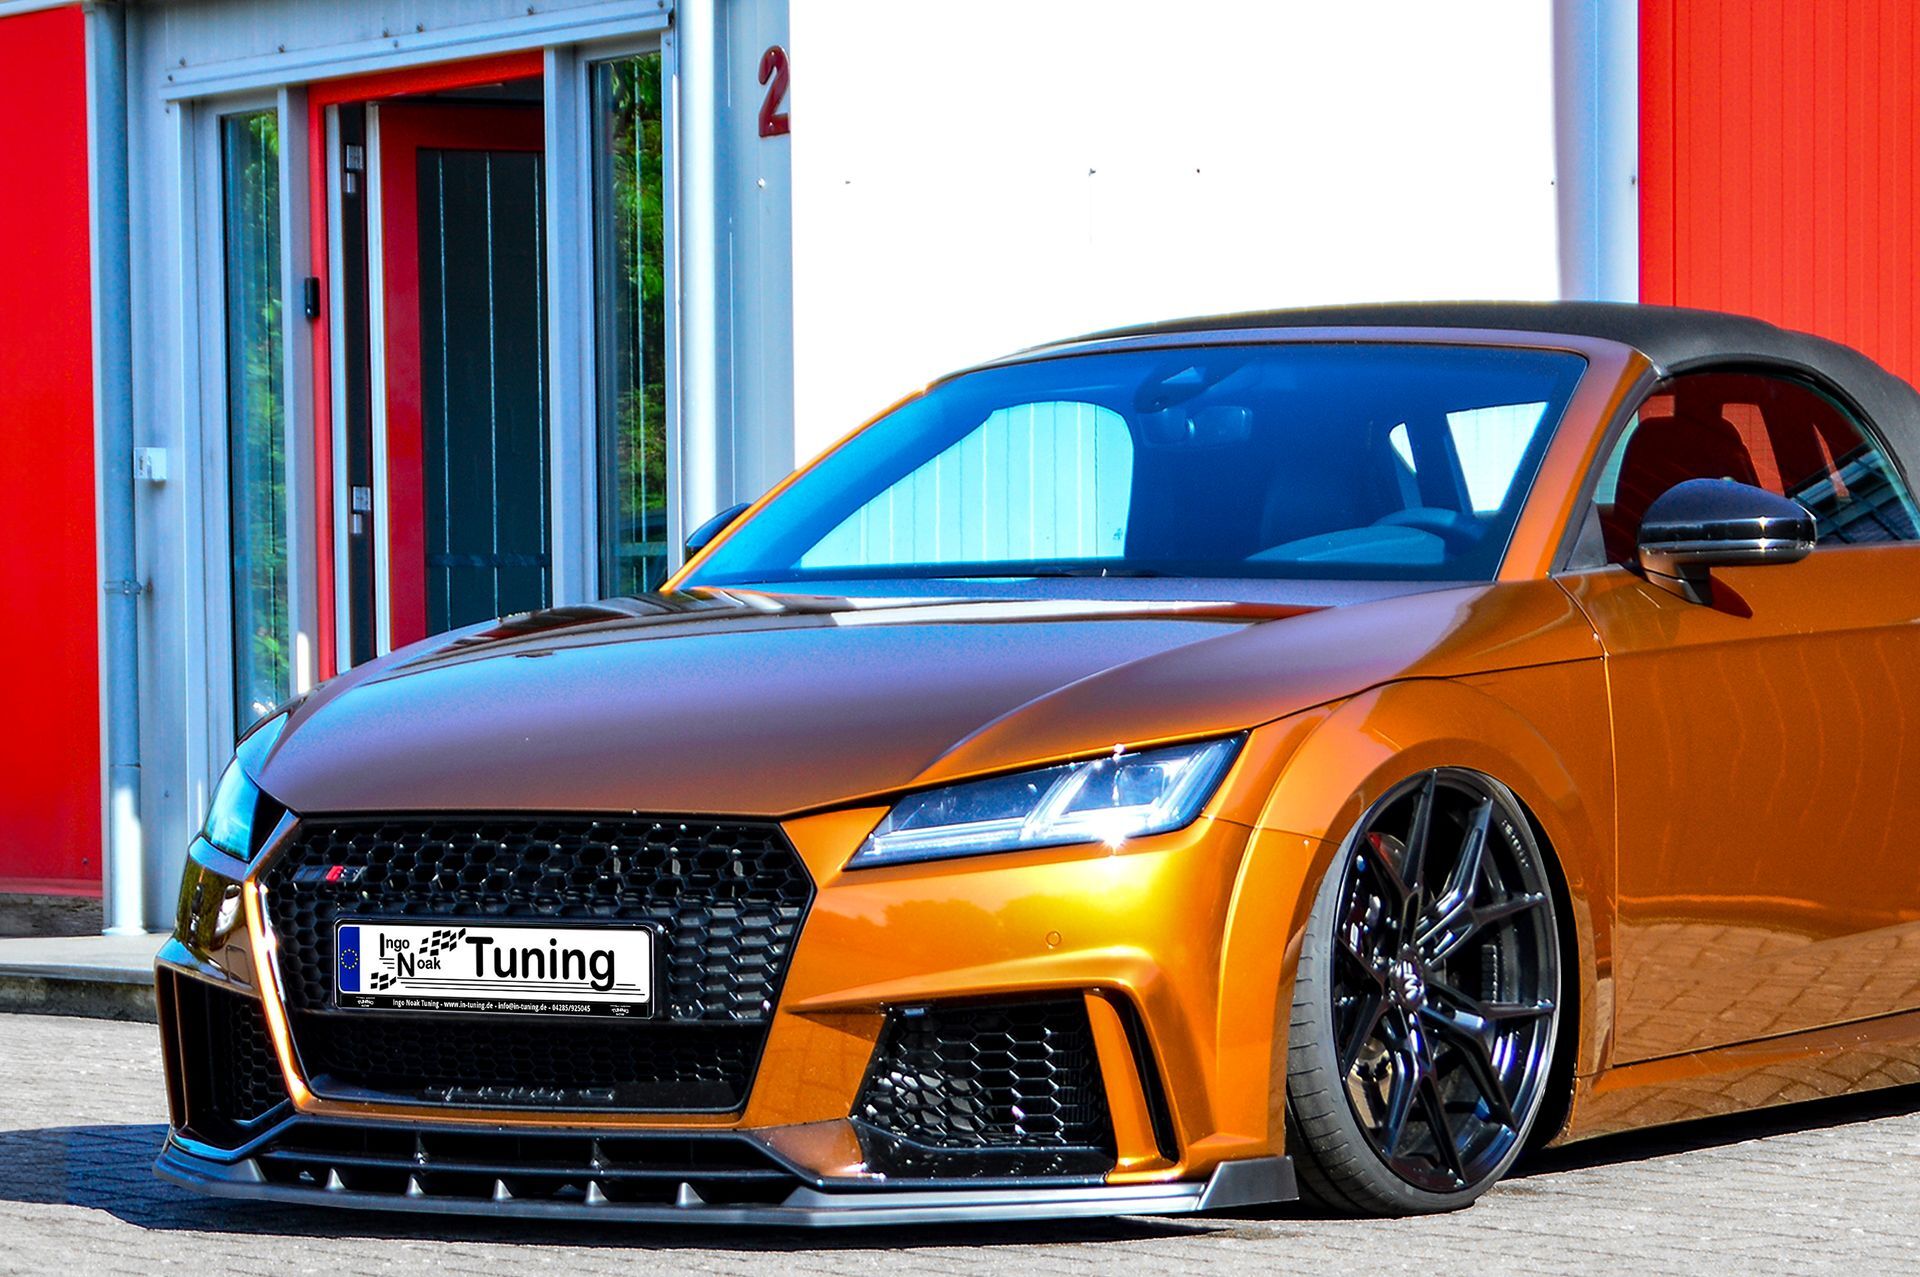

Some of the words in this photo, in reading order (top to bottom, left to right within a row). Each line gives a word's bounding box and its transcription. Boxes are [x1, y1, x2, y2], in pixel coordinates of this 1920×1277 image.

[758, 44, 790, 138] 2
[380, 933, 410, 957] Ingo
[397, 952, 441, 977] Noak
[465, 936, 615, 992] Tuning
[392, 998, 405, 1008] Ingo
[405, 999, 420, 1007] Noak
[421, 999, 439, 1009] Tuning
[551, 1004, 591, 1012] 04285/925045
